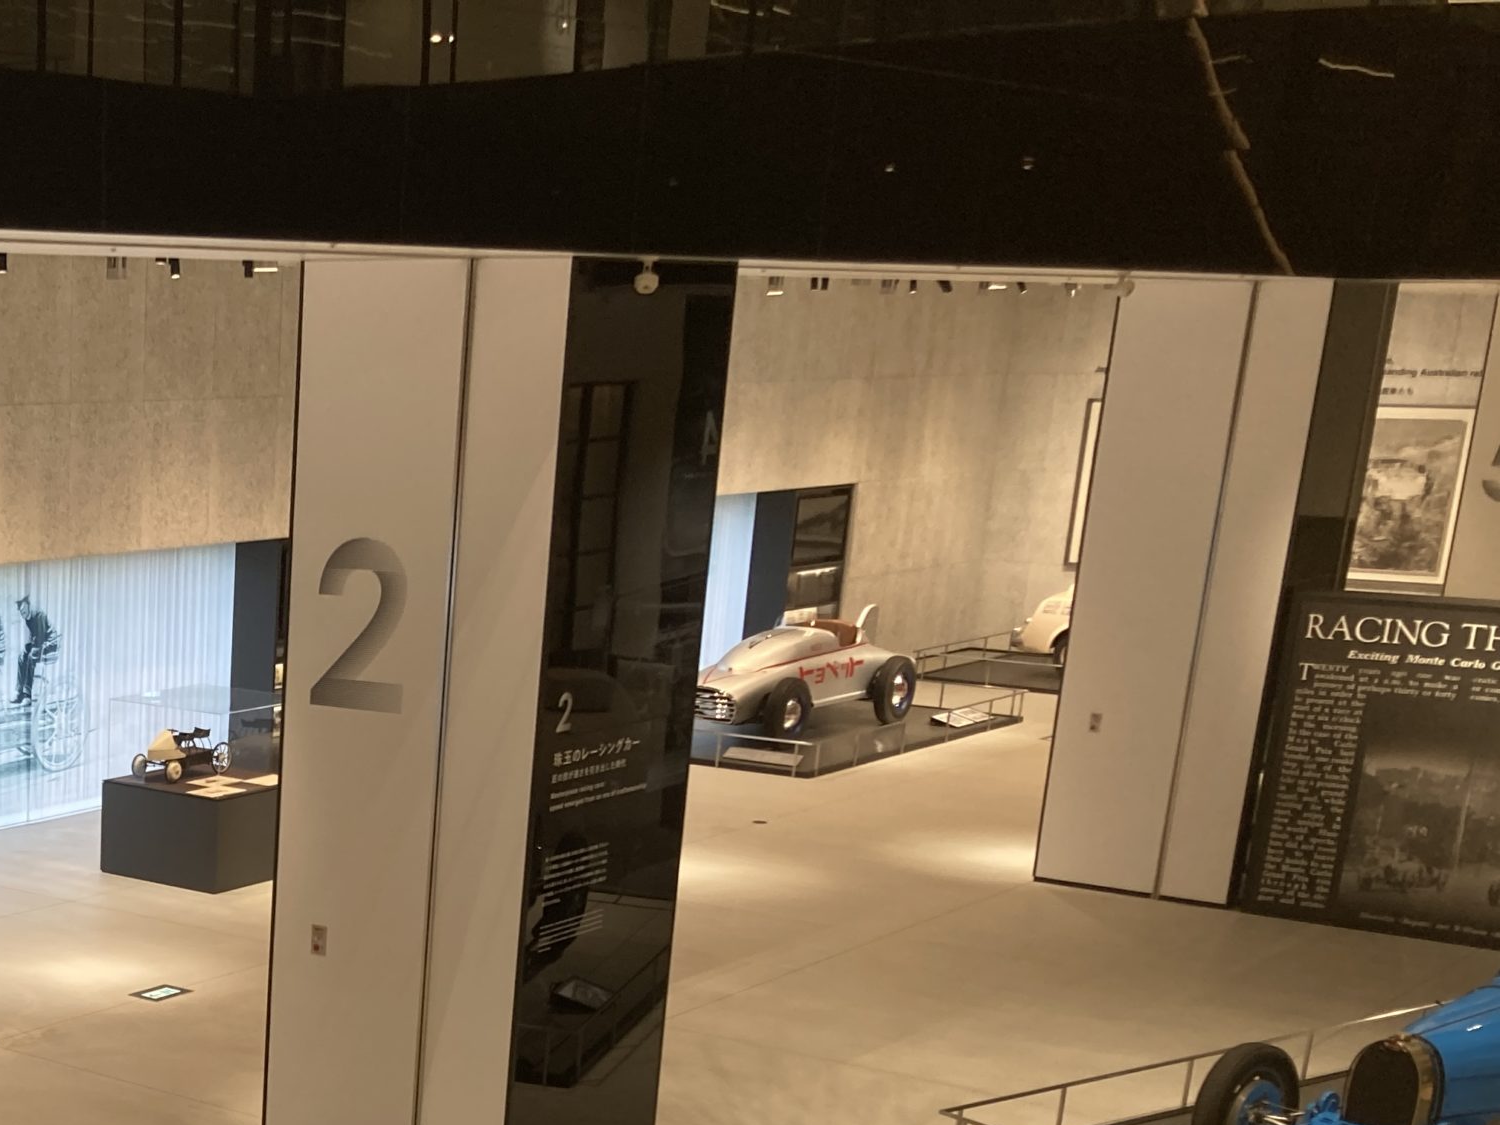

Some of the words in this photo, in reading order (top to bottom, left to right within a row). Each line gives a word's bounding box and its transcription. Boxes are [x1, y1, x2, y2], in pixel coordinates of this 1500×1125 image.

[310, 537, 408, 714] 2
[1305, 613, 1450, 648] RACING
[1347, 650, 1400, 665] Exciting
[1405, 654, 1446, 667] Monte
[1450, 657, 1486, 669] Carlo
[555, 692, 573, 733] 2
